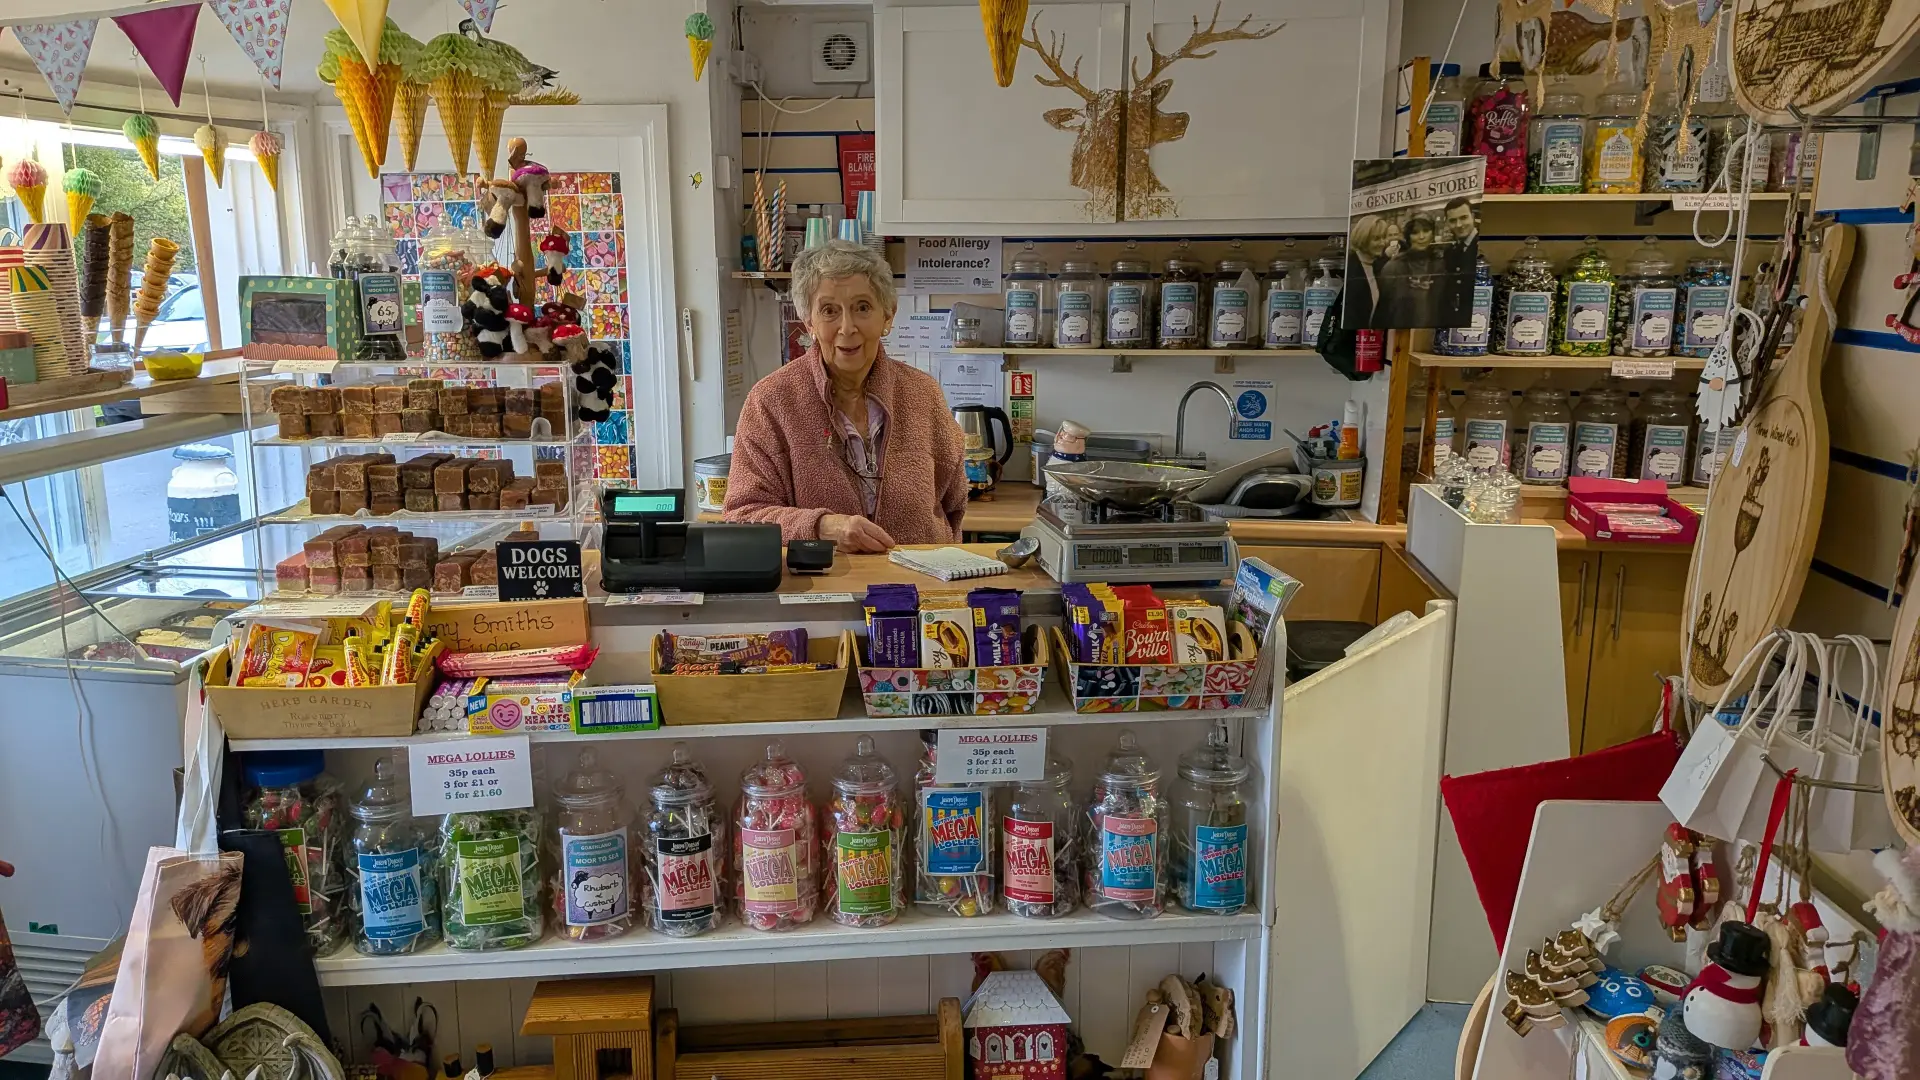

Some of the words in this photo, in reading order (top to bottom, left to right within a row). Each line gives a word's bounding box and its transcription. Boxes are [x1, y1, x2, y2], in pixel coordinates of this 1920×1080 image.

[1486, 110, 1519, 130] Ruffles
[858, 153, 874, 162] FIRE
[848, 163, 876, 172] BLANK
[1366, 188, 1421, 209] GENERAL
[1428, 175, 1478, 197] STORE
[918, 238, 946, 248] Food
[949, 238, 990, 250] Allergy
[918, 258, 990, 268] Intolerance?
[511, 548, 568, 564] DOGS
[502, 565, 580, 579] WELCOME
[1236, 582, 1264, 608] Yorkshire
[428, 622, 459, 640] my
[473, 609, 554, 635] Smith's
[1133, 620, 1159, 630] Cadbury
[710, 642, 740, 651] PEANUT
[1126, 629, 1169, 657] Bourn
[264, 631, 295, 679] Double
[730, 646, 762, 661] BRITTLE
[992, 639, 1001, 663] MILK
[1135, 643, 1169, 658] ville
[261, 698, 301, 710] HERB
[309, 696, 372, 709] GARDEN
[469, 698, 486, 711] NEW
[290, 712, 346, 721] Rosemary
[525, 714, 570, 724] HEARTS
[427, 754, 462, 764] MEGA
[466, 750, 516, 761] LOLLIES
[449, 770, 468, 778] 35p
[472, 767, 495, 775] each
[454, 780, 468, 788] for
[455, 791, 469, 799] for
[473, 789, 502, 798] £1.60
[930, 816, 980, 848] MEGA
[581, 842, 611, 850] GOATHLAND
[939, 839, 979, 850] LOLLIES
[675, 861, 692, 869] COLA
[840, 857, 866, 868] TROPICAL
[1006, 846, 1052, 872] MEGA
[1106, 844, 1153, 872] MEGA
[1199, 848, 1244, 880] MEGA
[476, 863, 497, 873] APPLE
[746, 854, 795, 887] MEGA
[841, 854, 889, 888] MEGA
[1114, 866, 1153, 875] LOLLIES
[464, 861, 519, 900] MEGA
[662, 859, 711, 896] MEGA
[753, 878, 793, 888] LOLLIES
[849, 878, 889, 891] LOLLIES
[1207, 872, 1244, 884] LOLLIES
[584, 880, 618, 891] Rhubarb
[671, 882, 711, 896] LOLLIES
[365, 876, 419, 913] MEGA
[474, 886, 519, 900] LOLLIES
[374, 899, 418, 914] LOLLIES
[584, 895, 614, 907] Custard
